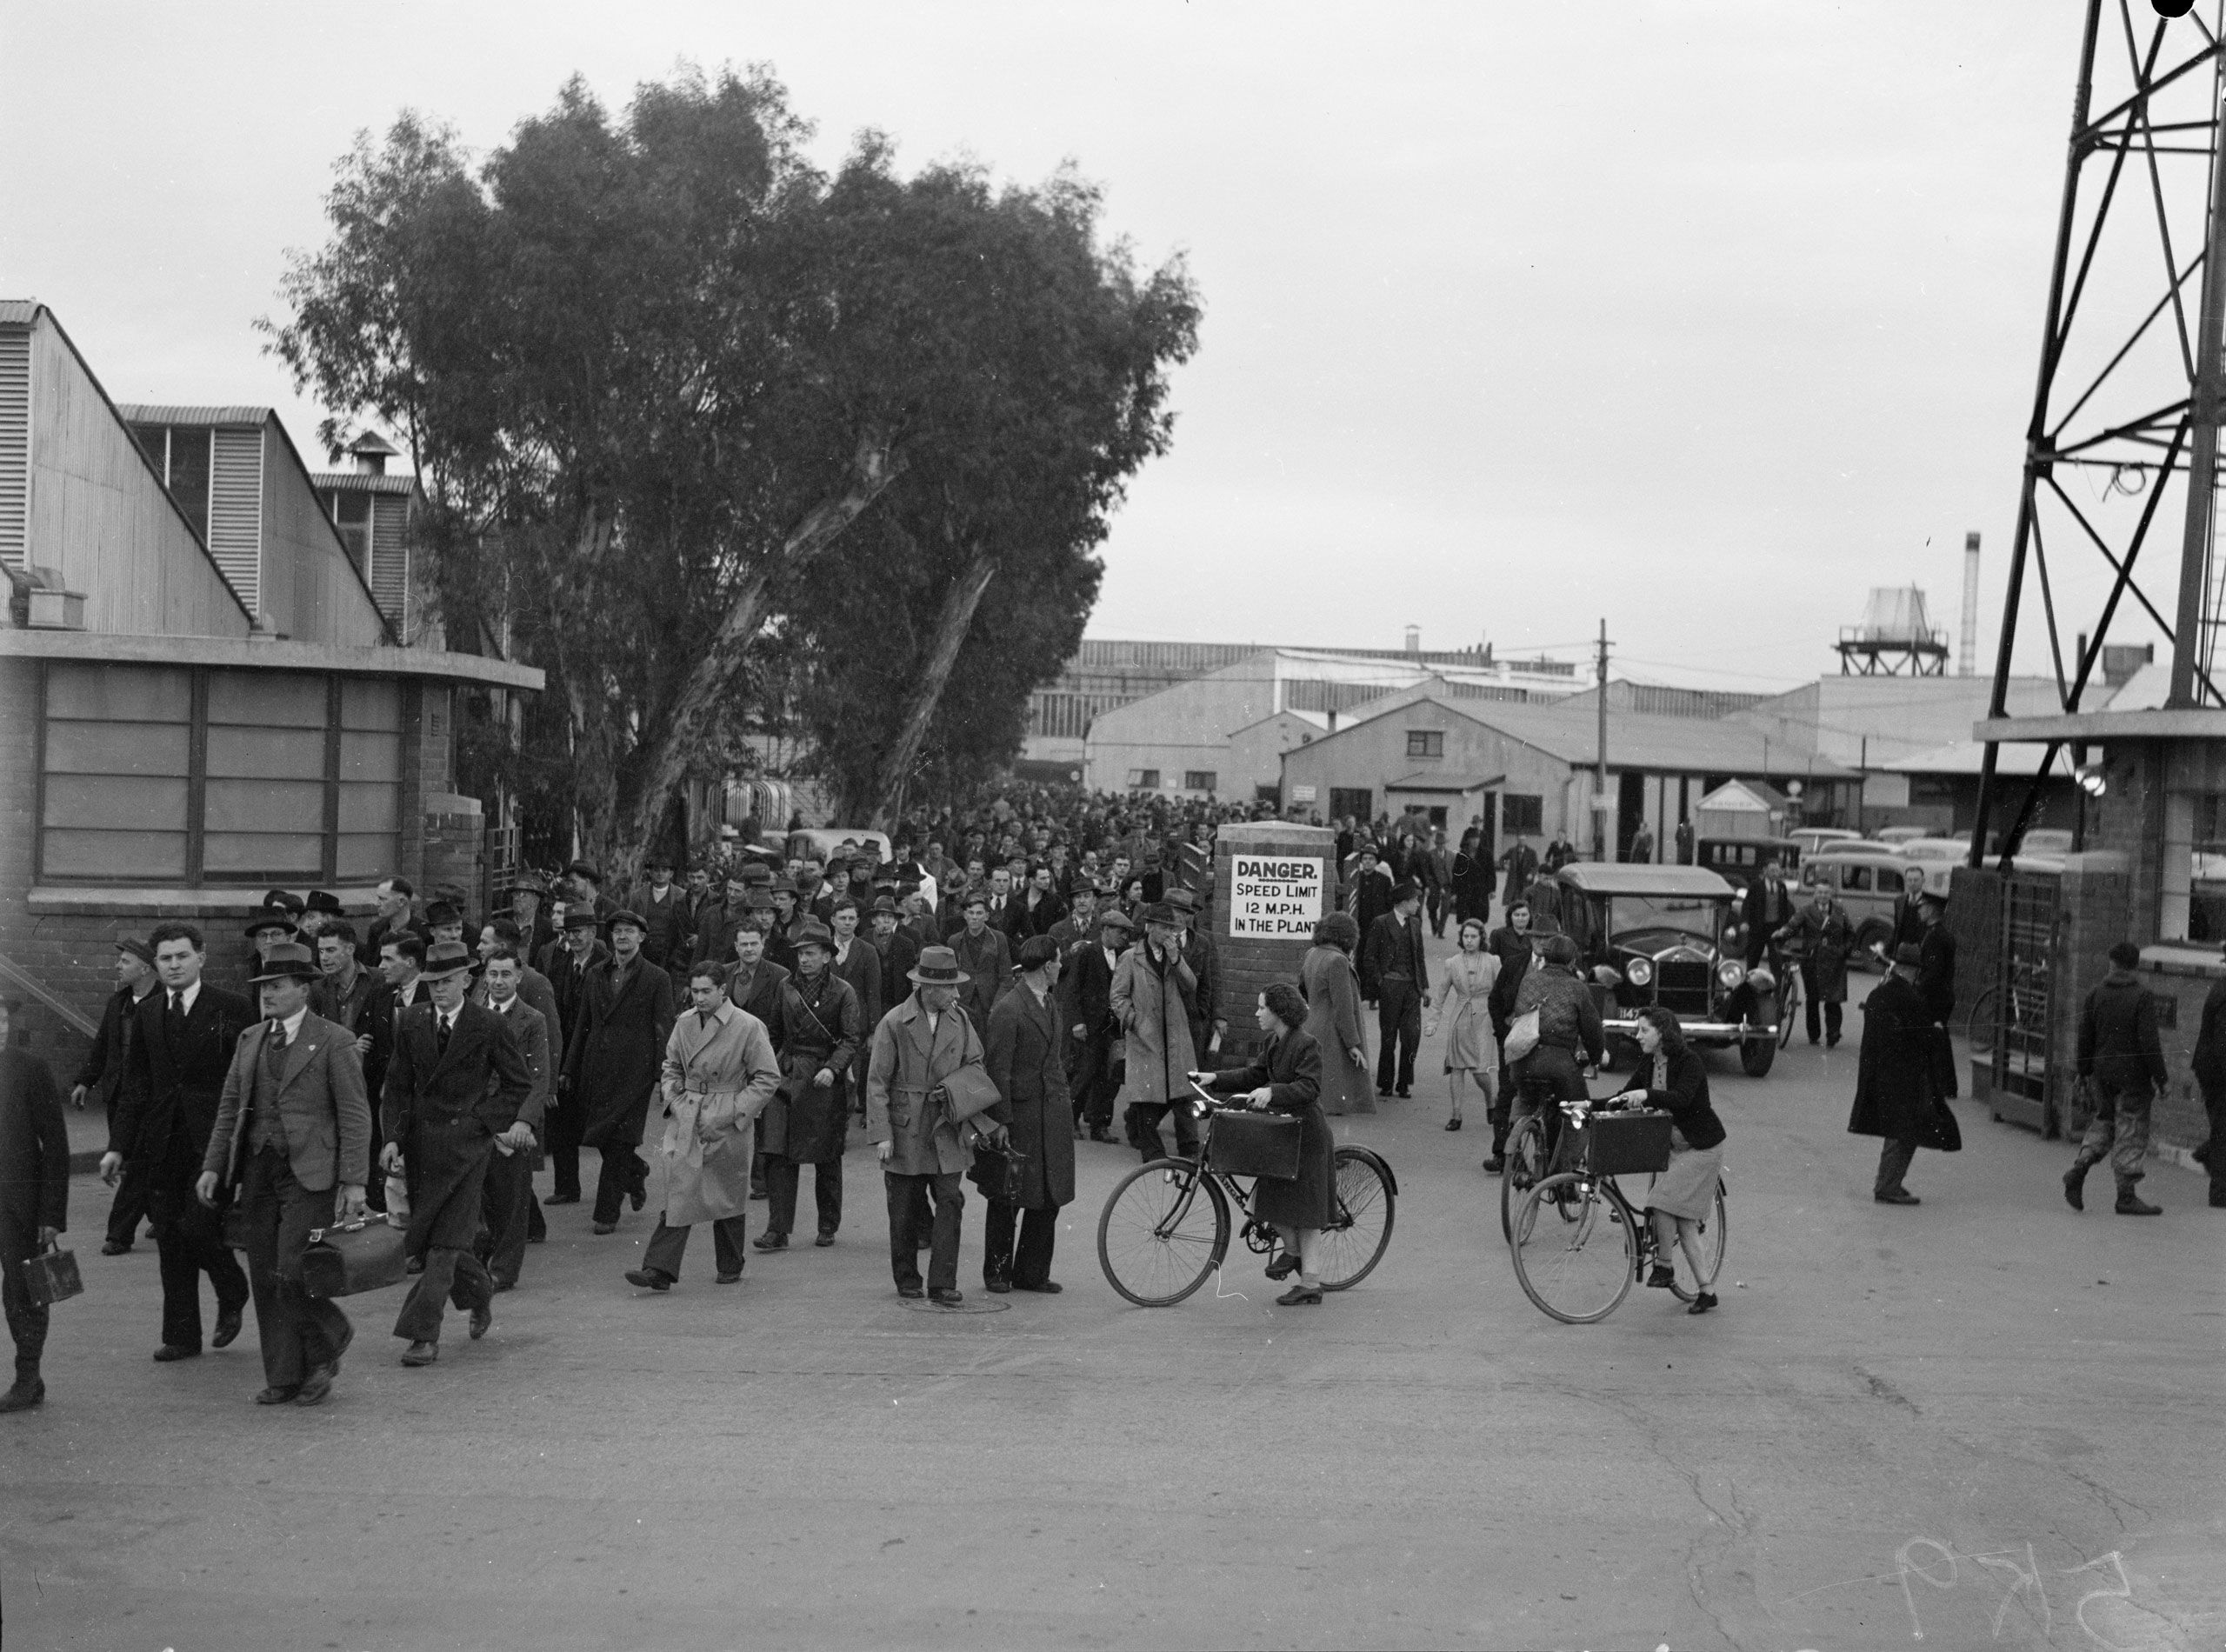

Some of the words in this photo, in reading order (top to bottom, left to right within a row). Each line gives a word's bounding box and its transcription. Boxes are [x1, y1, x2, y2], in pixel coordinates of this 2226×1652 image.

[1237, 861, 1317, 879] DANGER.
[1236, 883, 1281, 896] SPEED
[1286, 884, 1317, 897] LIMIT
[1246, 902, 1260, 914] 12
[1265, 903, 1305, 915] M.P.H.
[1235, 917, 1245, 931] IN
[1249, 918, 1273, 932] THE
